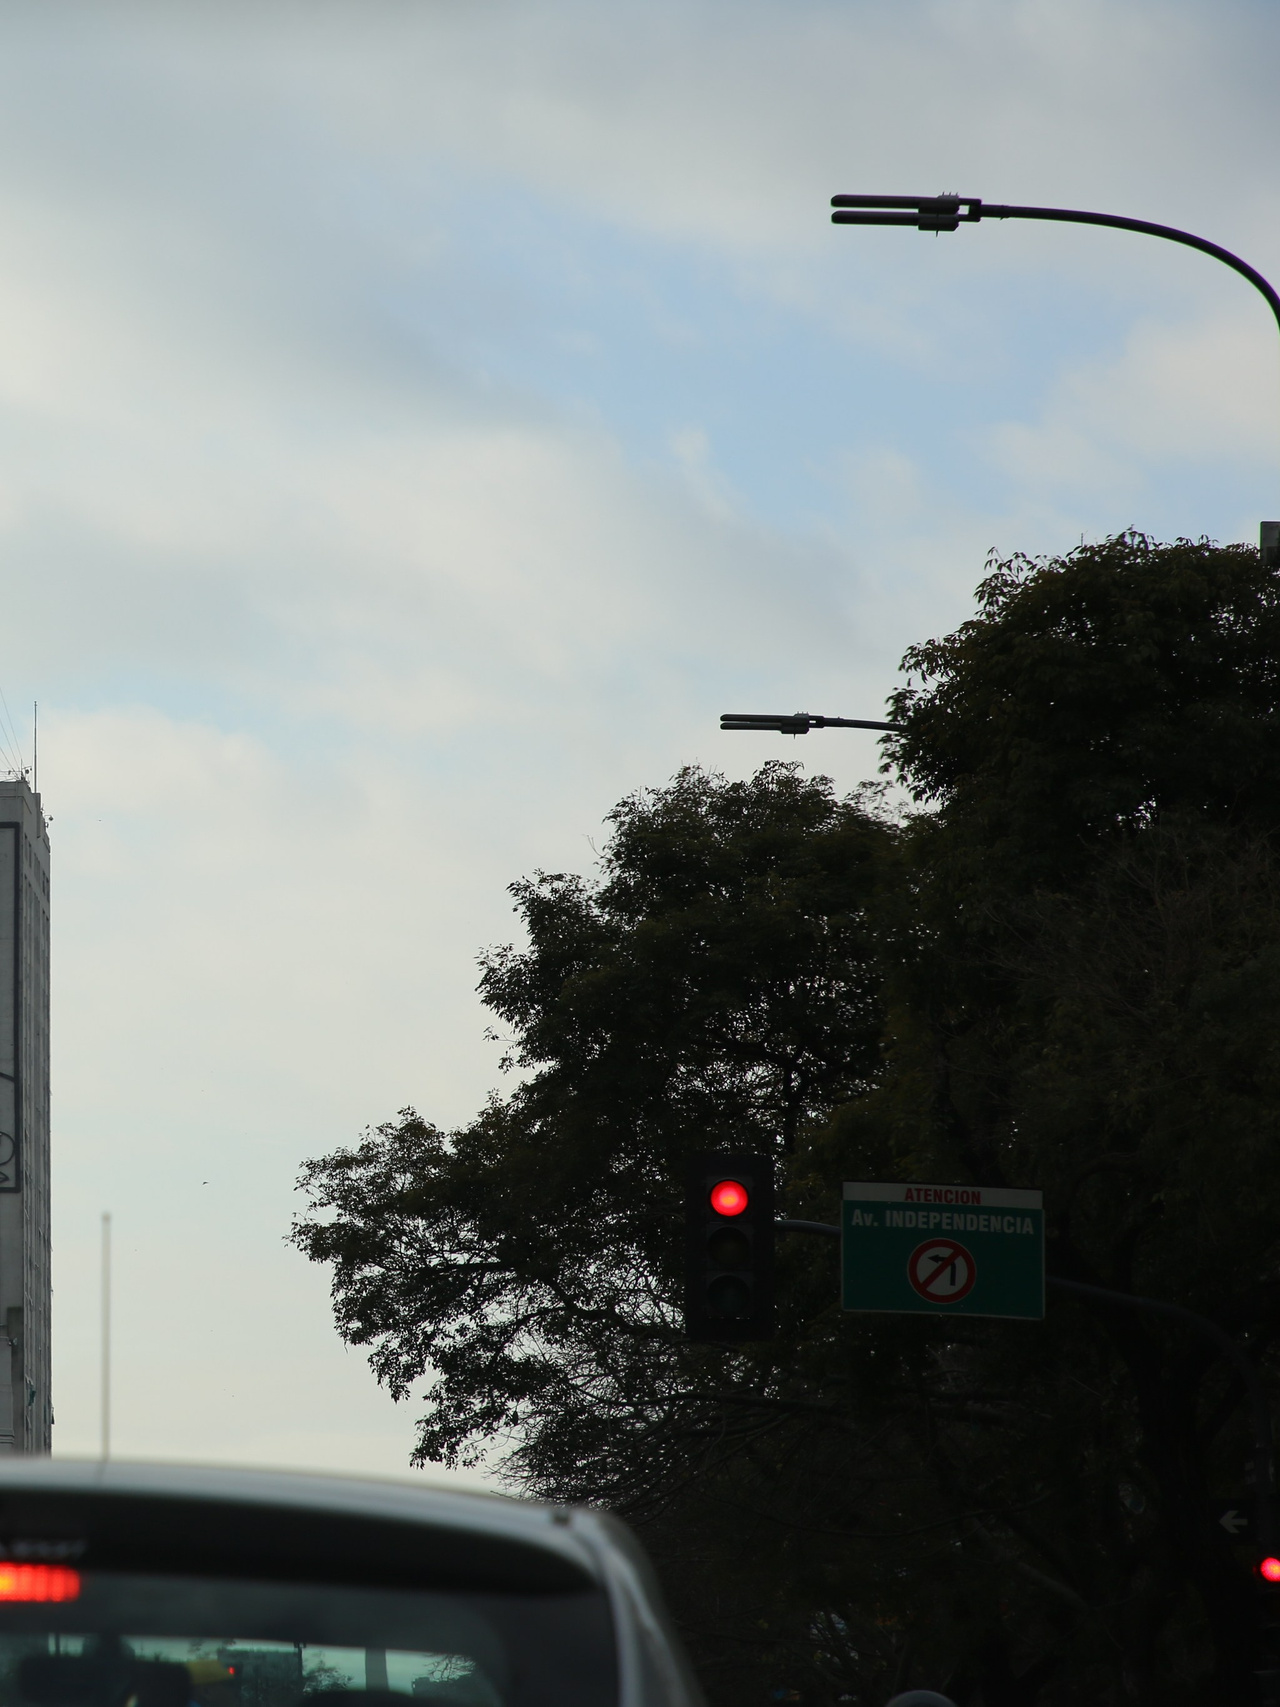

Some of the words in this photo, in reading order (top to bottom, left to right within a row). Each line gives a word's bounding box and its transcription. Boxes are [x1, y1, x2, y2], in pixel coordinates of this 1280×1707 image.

[904, 1187, 982, 1205] ATENCION
[851, 1208, 879, 1227] Av.
[885, 1210, 1035, 1235] INDEPENDENCIA
